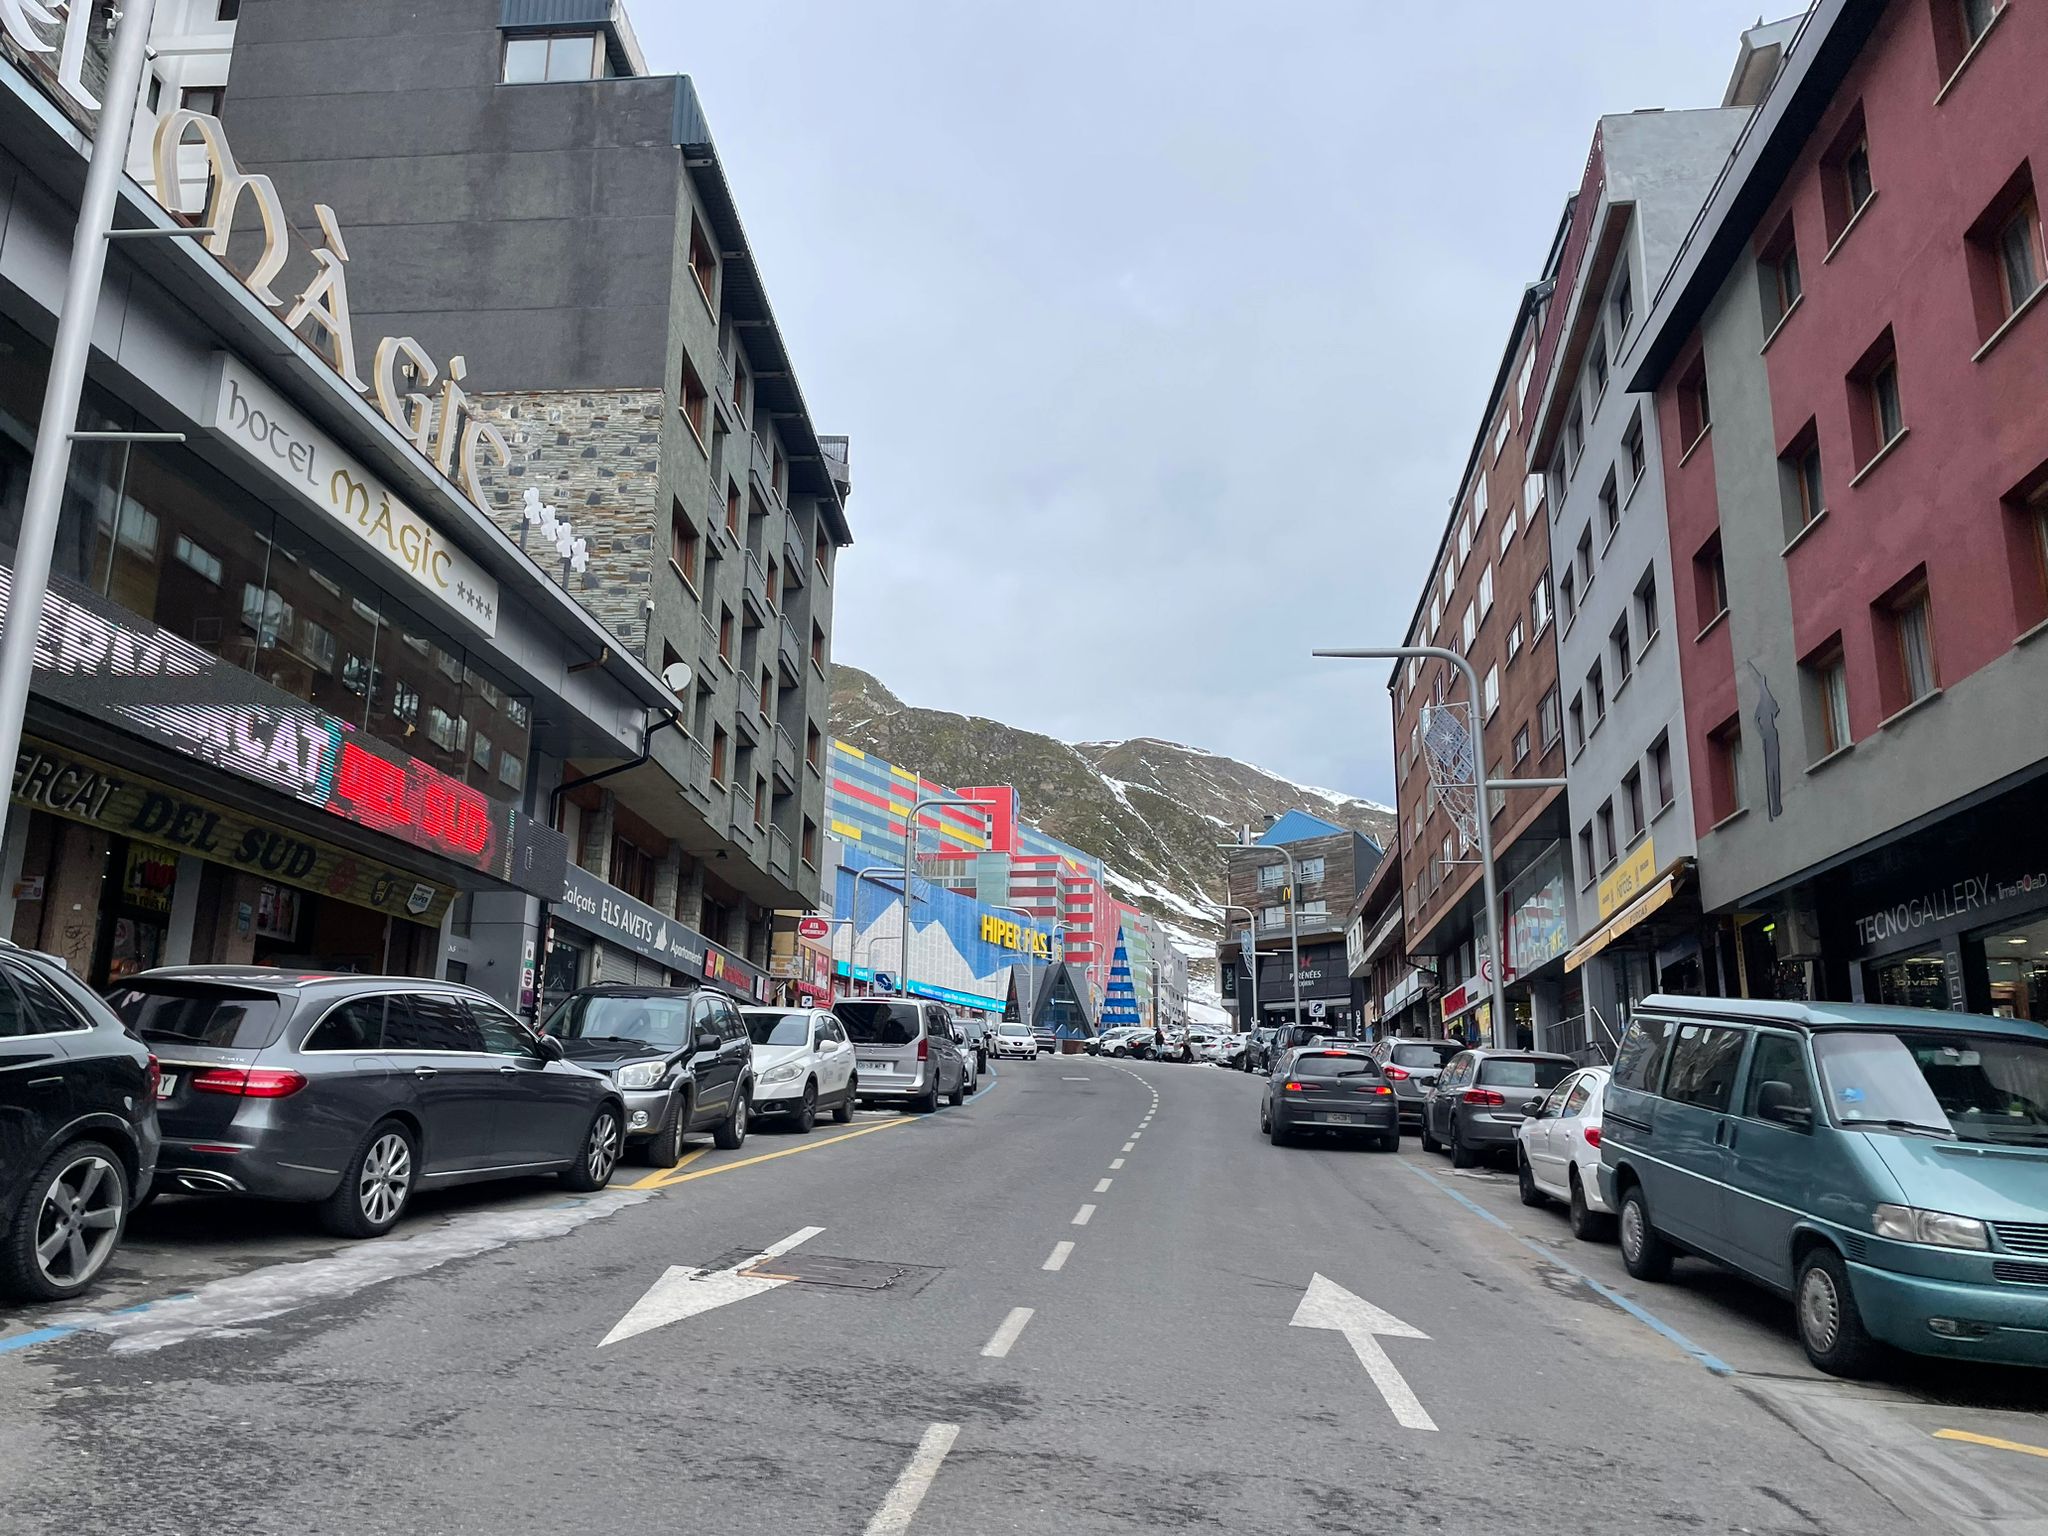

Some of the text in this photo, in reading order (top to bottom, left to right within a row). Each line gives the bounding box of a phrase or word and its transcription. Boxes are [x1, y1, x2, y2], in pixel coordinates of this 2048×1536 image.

[129, 792, 221, 851] DEL
[233, 827, 317, 879] SUD
[600, 898, 621, 928] ELS
[620, 909, 653, 943] AVETS
[982, 914, 1021, 950] HIPER
[1855, 873, 1990, 946] TECNOGALLERY
[1289, 970, 1322, 981] PRÉNÉES
